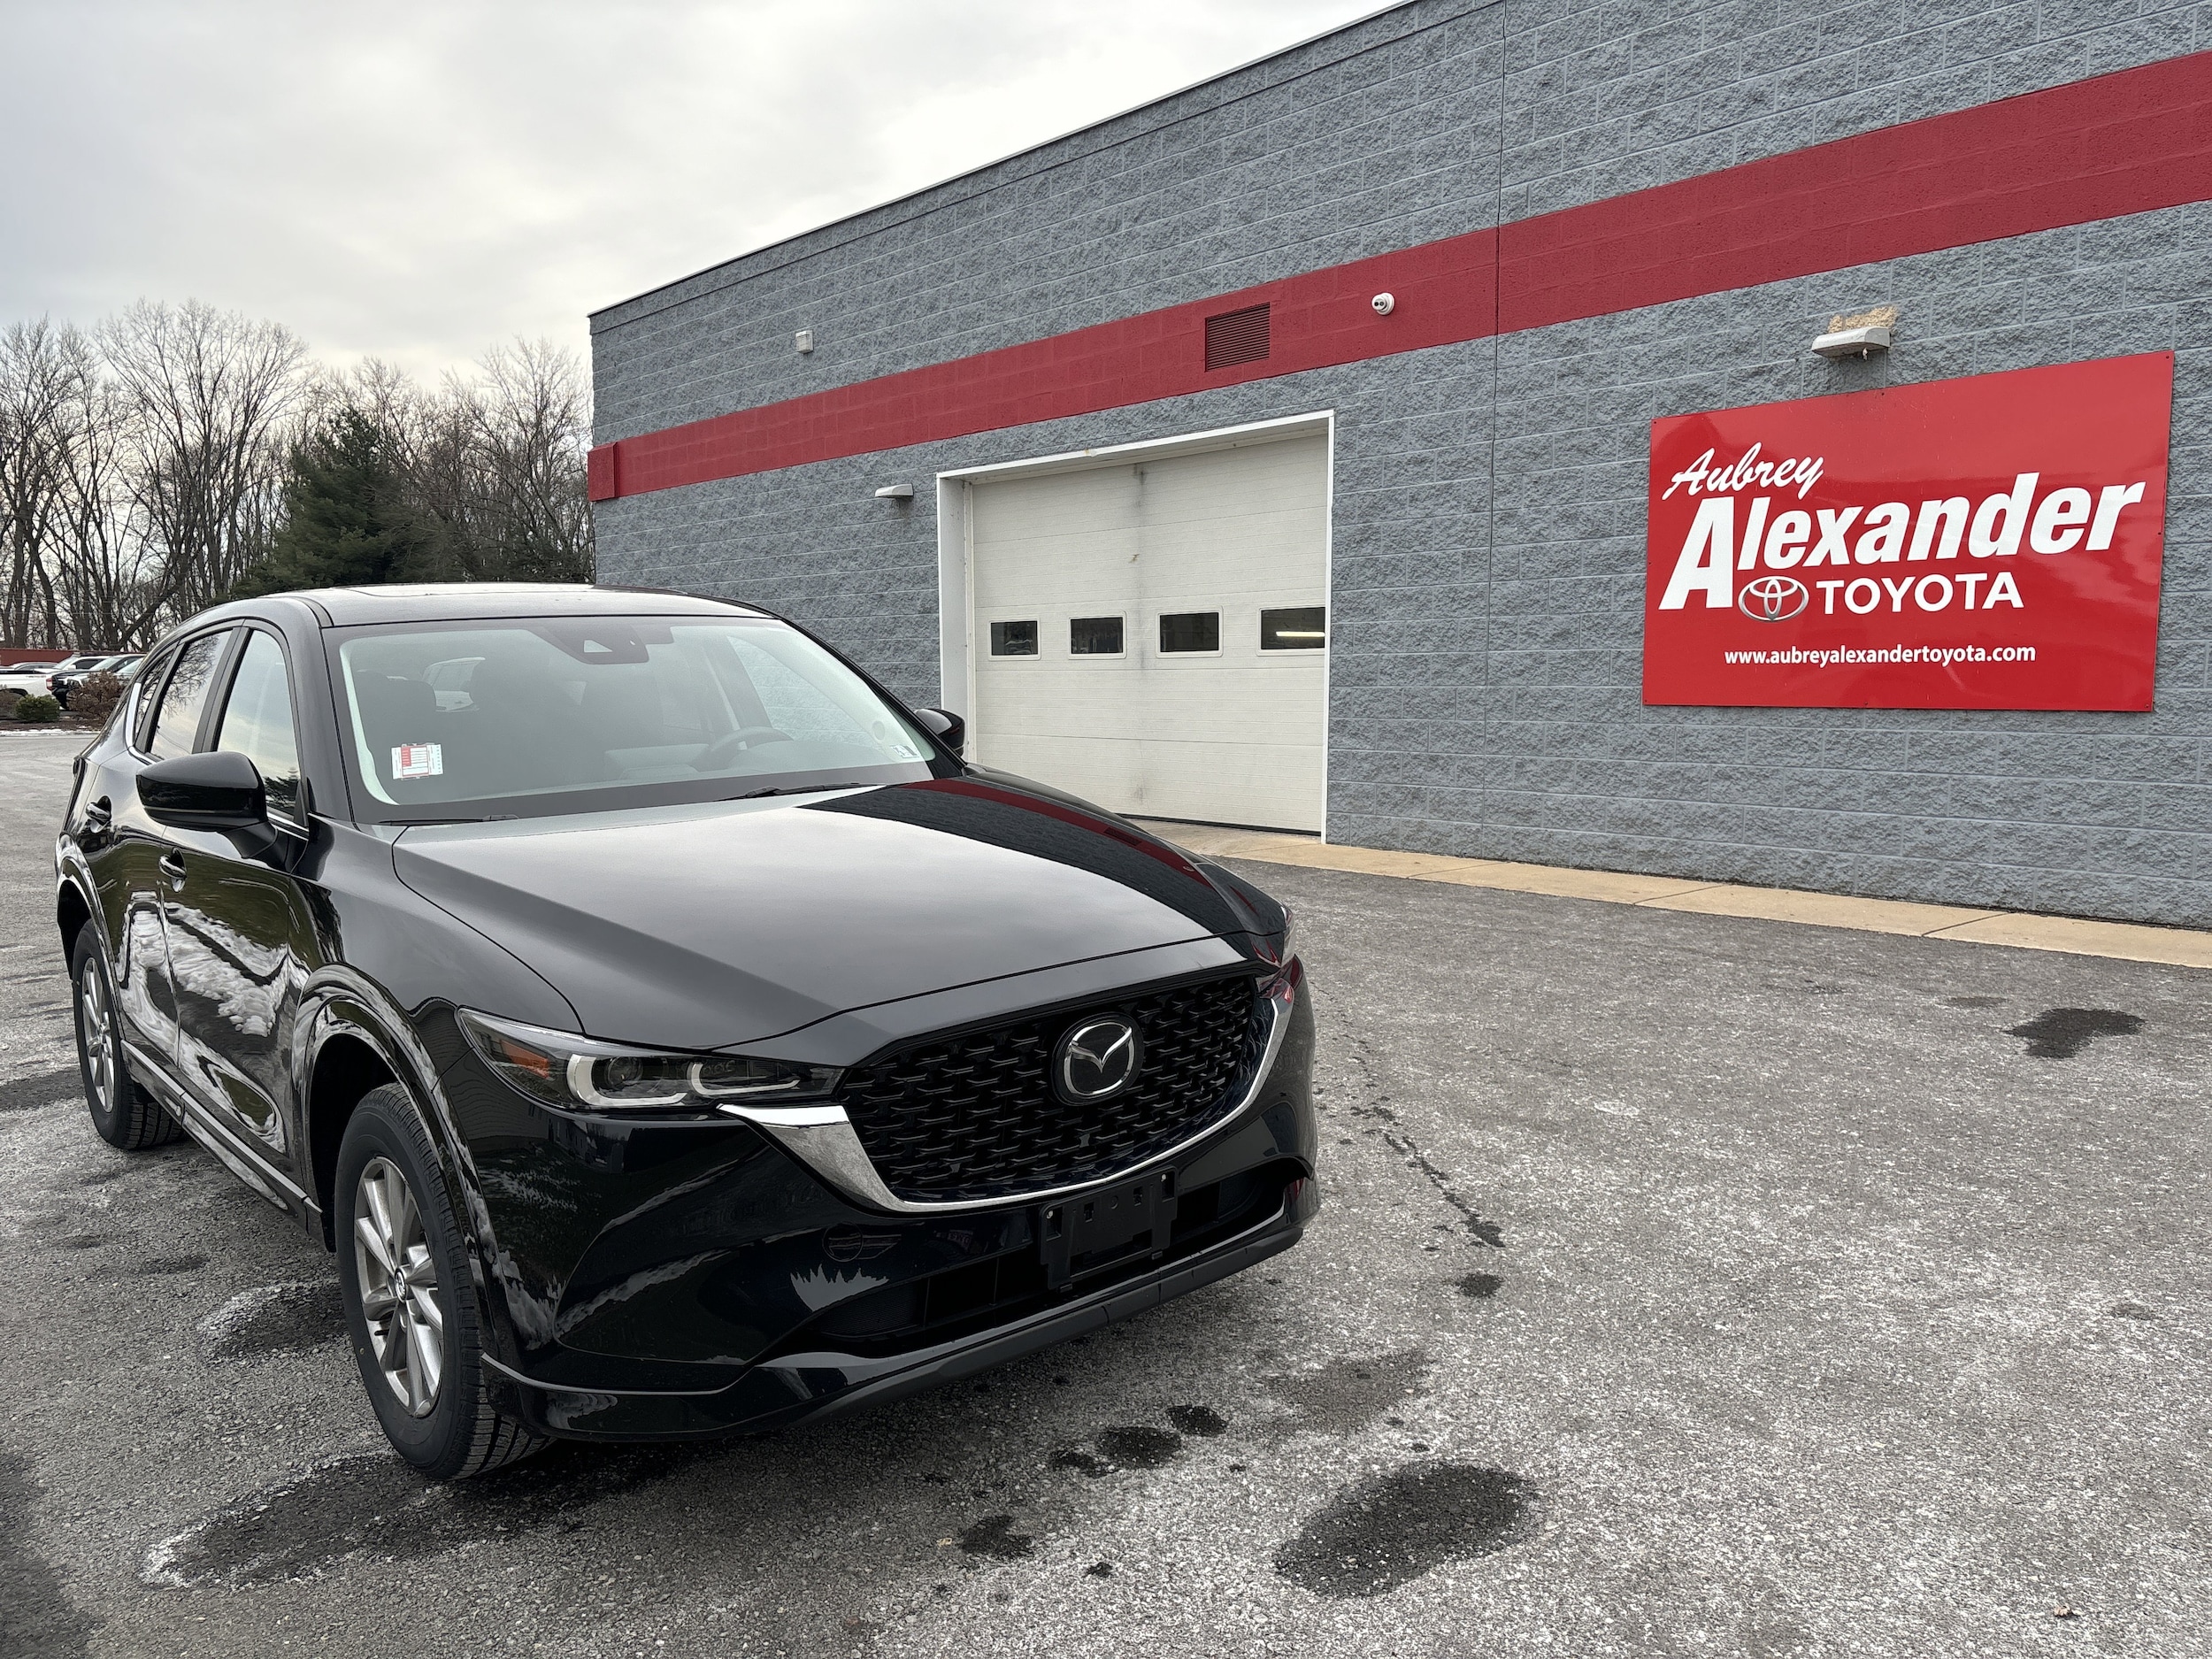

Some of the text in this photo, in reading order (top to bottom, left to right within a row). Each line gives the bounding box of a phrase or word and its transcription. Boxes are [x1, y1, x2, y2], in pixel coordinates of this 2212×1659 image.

[1662, 442, 1824, 501] Aubrey
[1658, 472, 2147, 611] Alexander
[1816, 572, 2024, 615] TOYOTA
[1724, 643, 2036, 668] www.aubreyalexandertoyota.com
